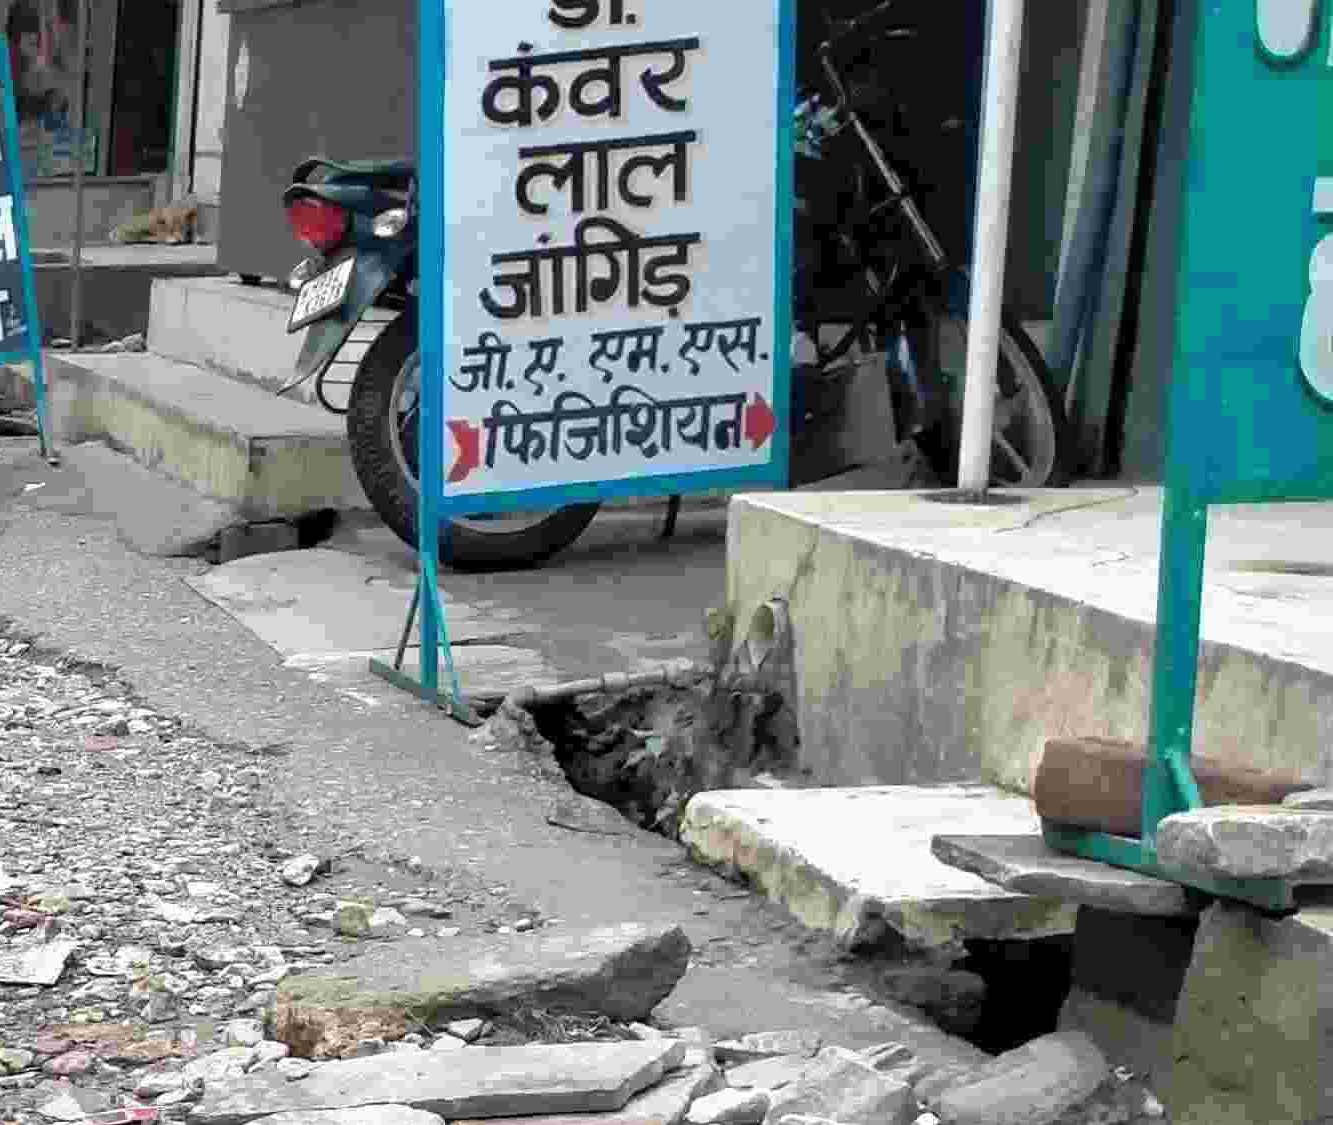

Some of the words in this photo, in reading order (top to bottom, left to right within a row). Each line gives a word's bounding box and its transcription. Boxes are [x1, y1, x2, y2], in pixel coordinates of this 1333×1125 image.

[481, 37, 700, 128] कंवर
[514, 130, 697, 215] लाल
[478, 217, 701, 321] जांगिड़
